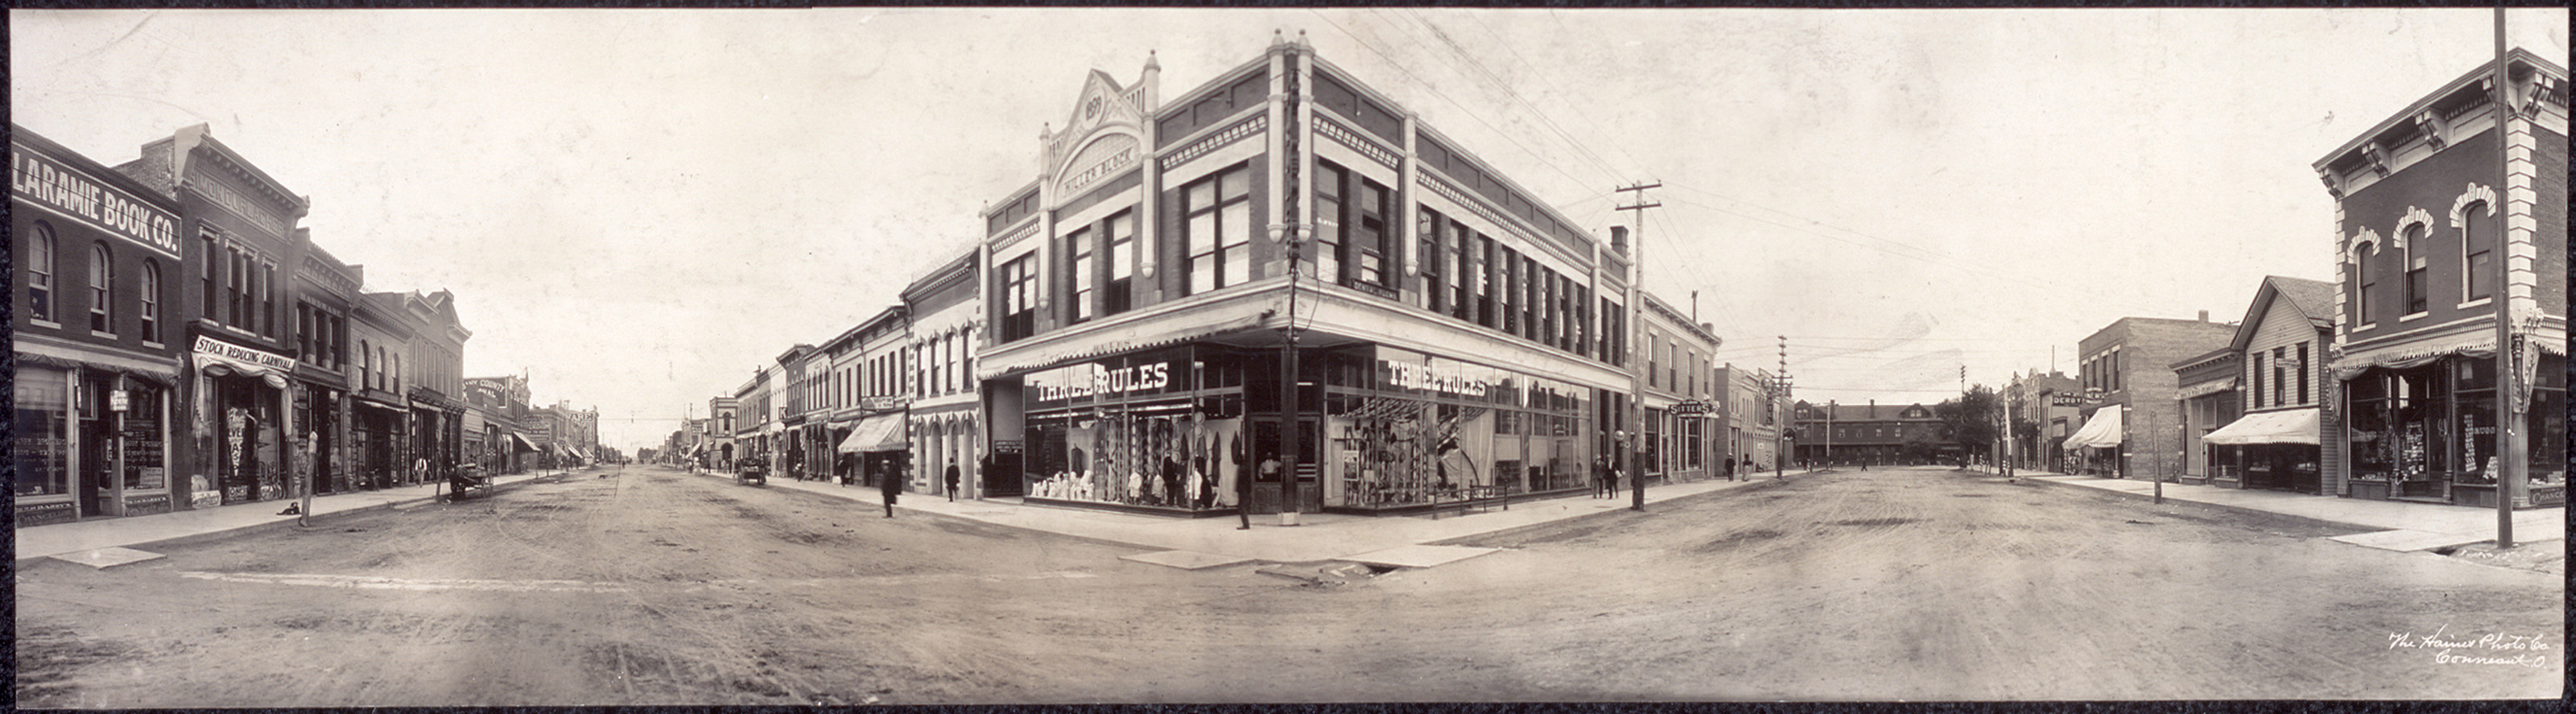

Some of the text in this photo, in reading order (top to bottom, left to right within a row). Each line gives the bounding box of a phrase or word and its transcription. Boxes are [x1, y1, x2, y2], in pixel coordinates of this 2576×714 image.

[1064, 148, 1133, 196] MILLER BLOCK
[12, 151, 178, 252] LARAMIE BOOK CO.
[225, 188, 284, 238] DURLACHER
[299, 291, 344, 318] HARDWARE
[197, 339, 291, 369] STOCK REDUCING CARNIVAL
[480, 379, 506, 393] COUNTY
[1094, 362, 1168, 394] RULES
[1670, 404, 1710, 415] SITTERS
